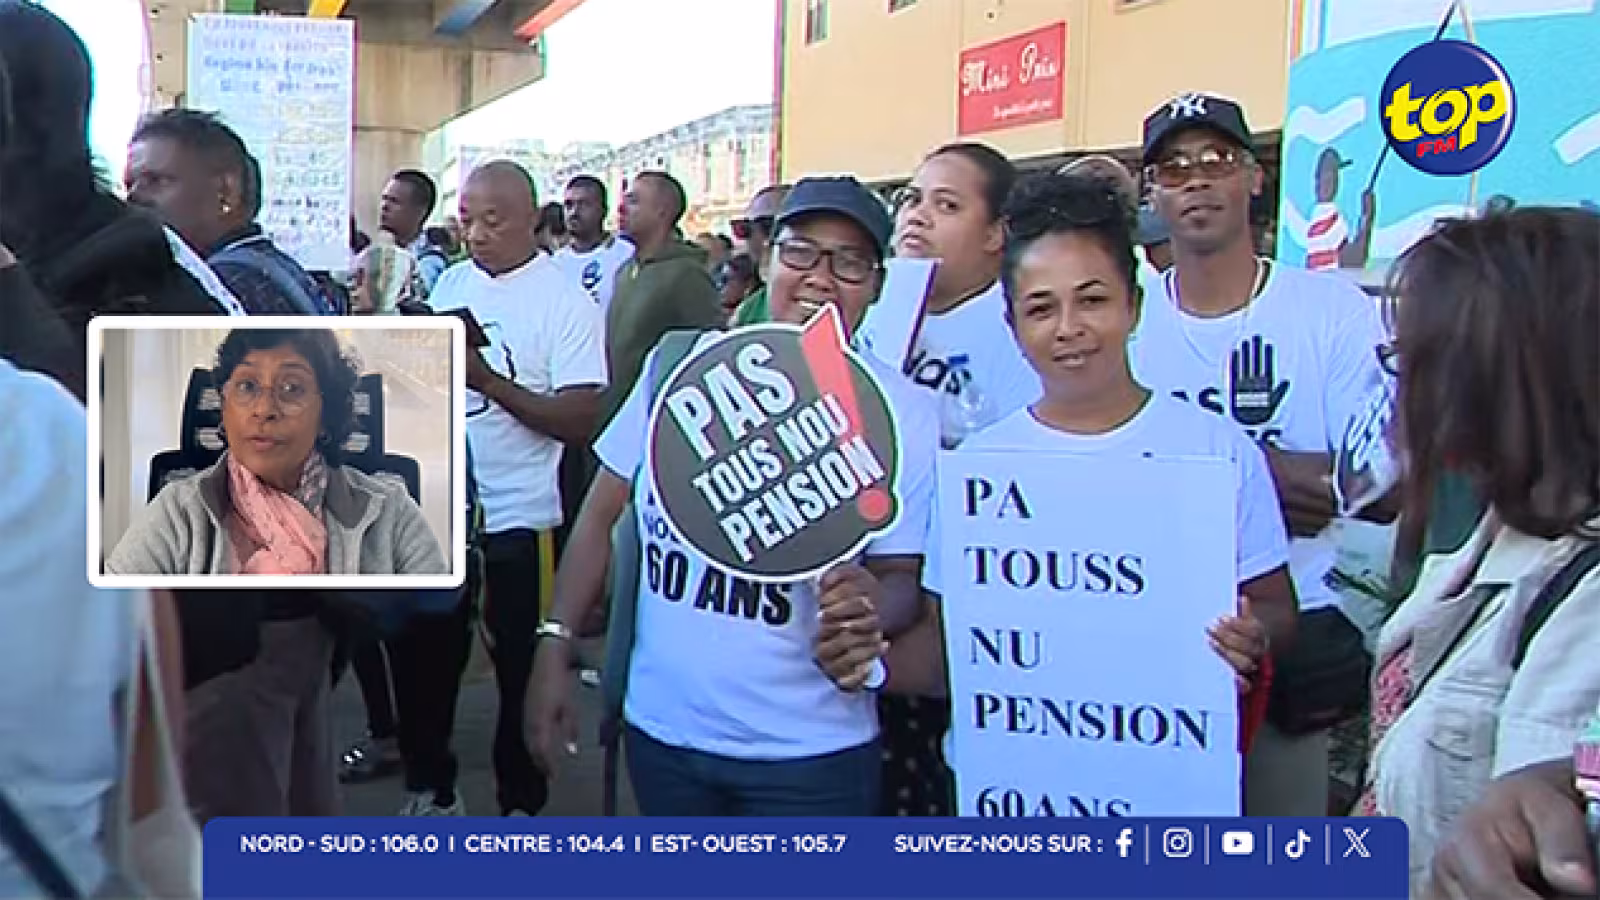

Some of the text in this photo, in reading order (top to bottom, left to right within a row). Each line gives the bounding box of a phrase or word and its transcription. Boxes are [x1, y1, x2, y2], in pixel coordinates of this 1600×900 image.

[667, 343, 796, 462] PAS
[692, 393, 849, 513] TOUS NOU
[719, 434, 887, 563] PENSION
[964, 477, 1032, 519] PA
[646, 543, 793, 626] 60 ANS
[963, 545, 1145, 596] TOUSS
[968, 626, 1042, 671] NU
[973, 692, 1211, 750] PENSION
